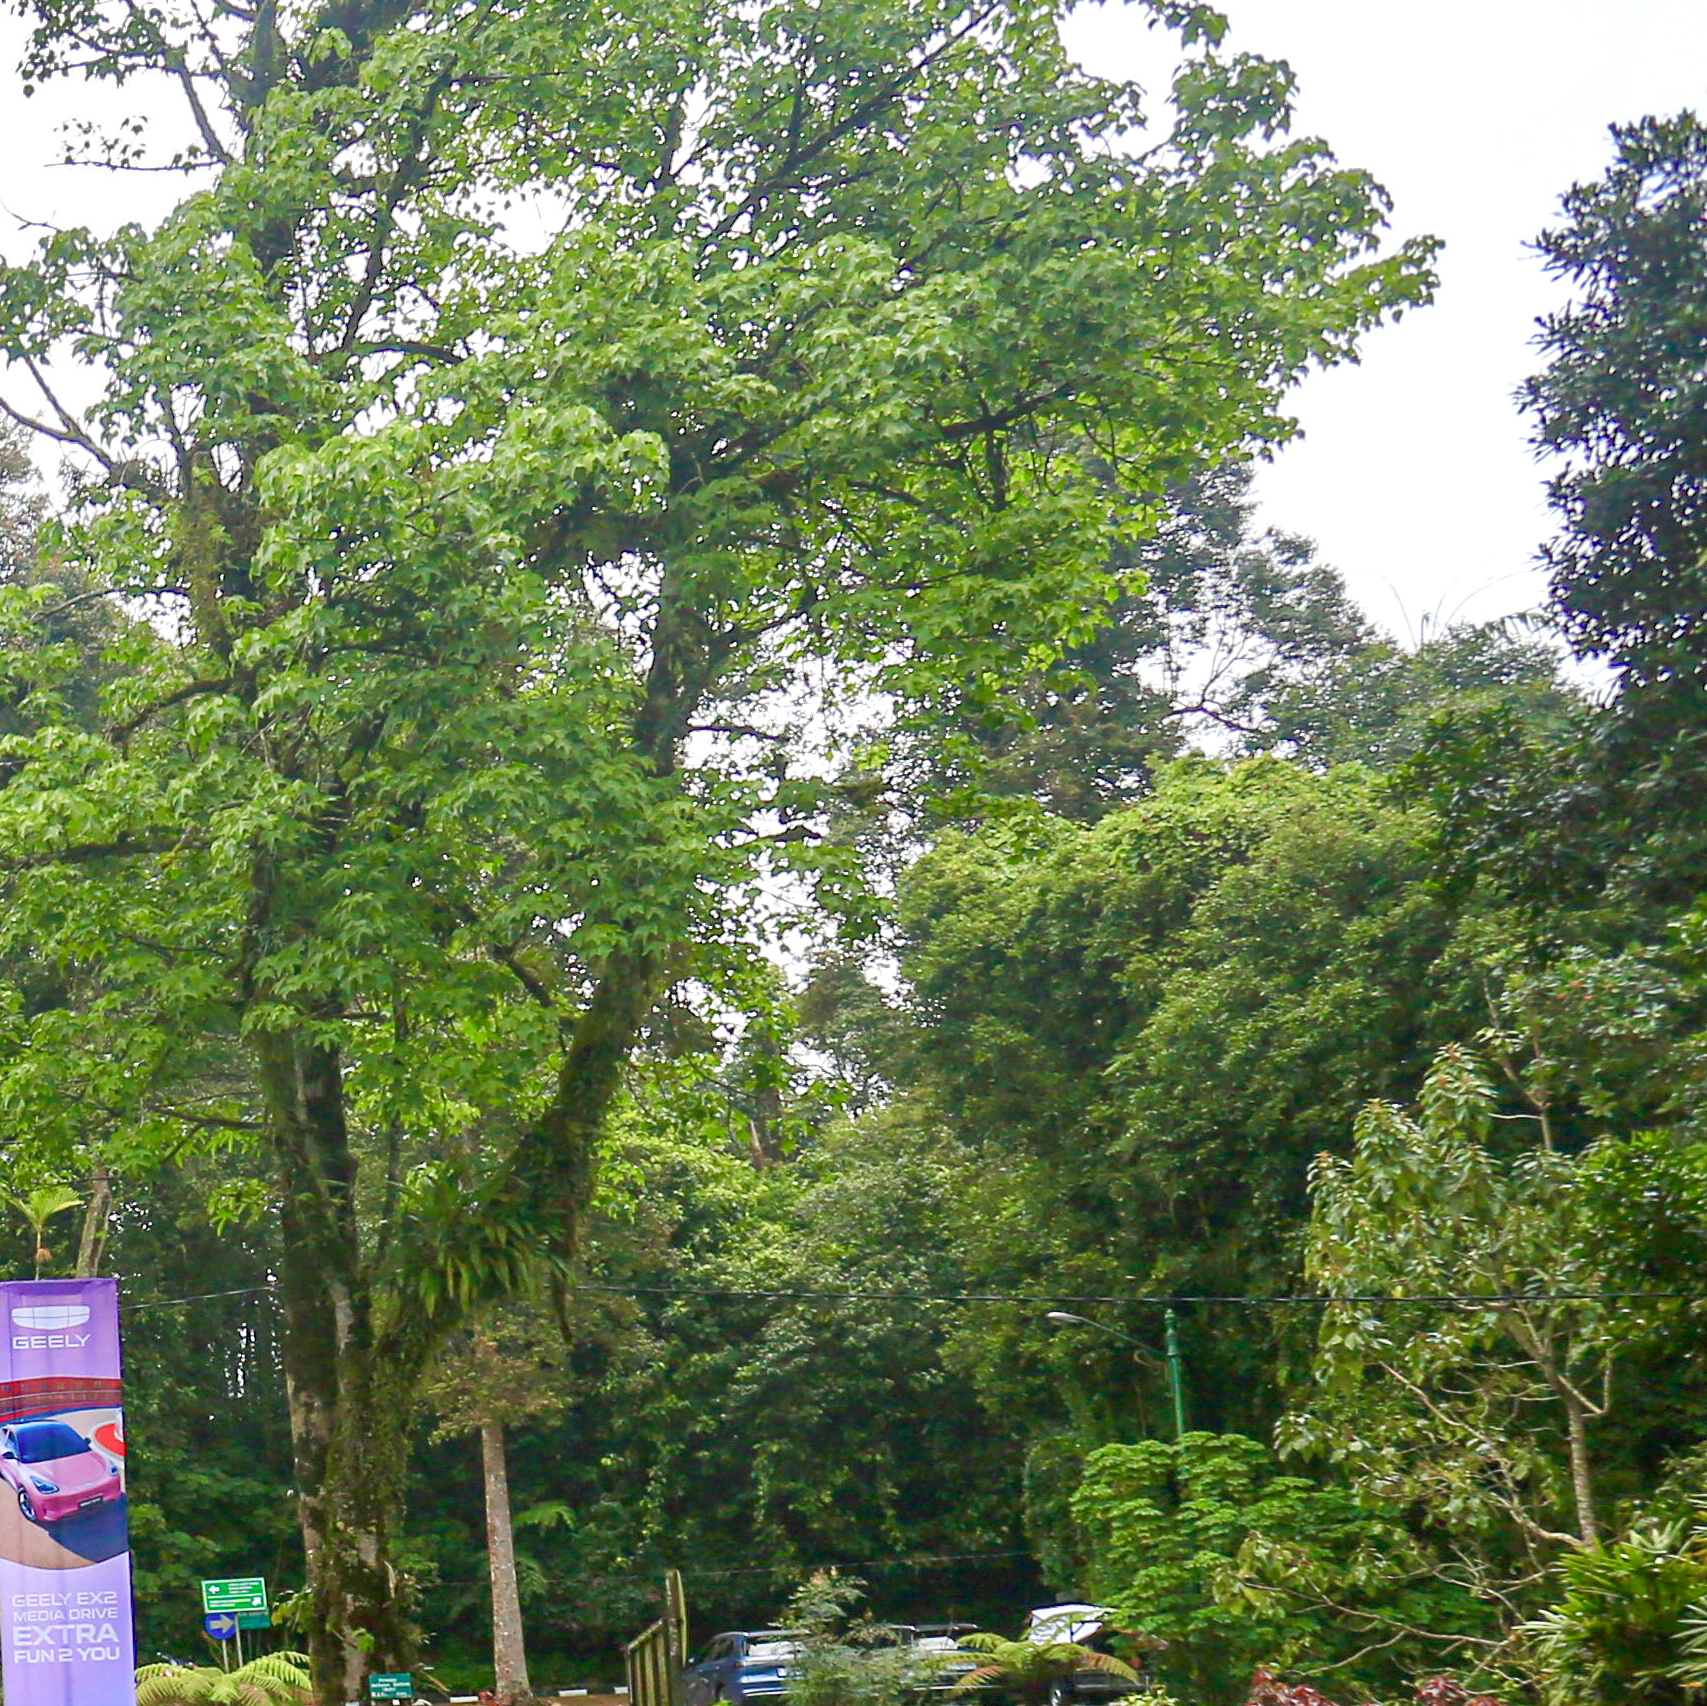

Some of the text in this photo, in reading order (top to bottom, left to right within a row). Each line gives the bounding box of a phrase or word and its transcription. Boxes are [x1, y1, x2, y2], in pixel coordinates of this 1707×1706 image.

[12, 1334, 91, 1350] GEELY
[12, 1591, 118, 1607] GEELY EX2
[13, 1607, 118, 1622] MEDIA DRIVE
[13, 1623, 119, 1646] EXTRA
[14, 1646, 120, 1664] FUN 2 YOU
